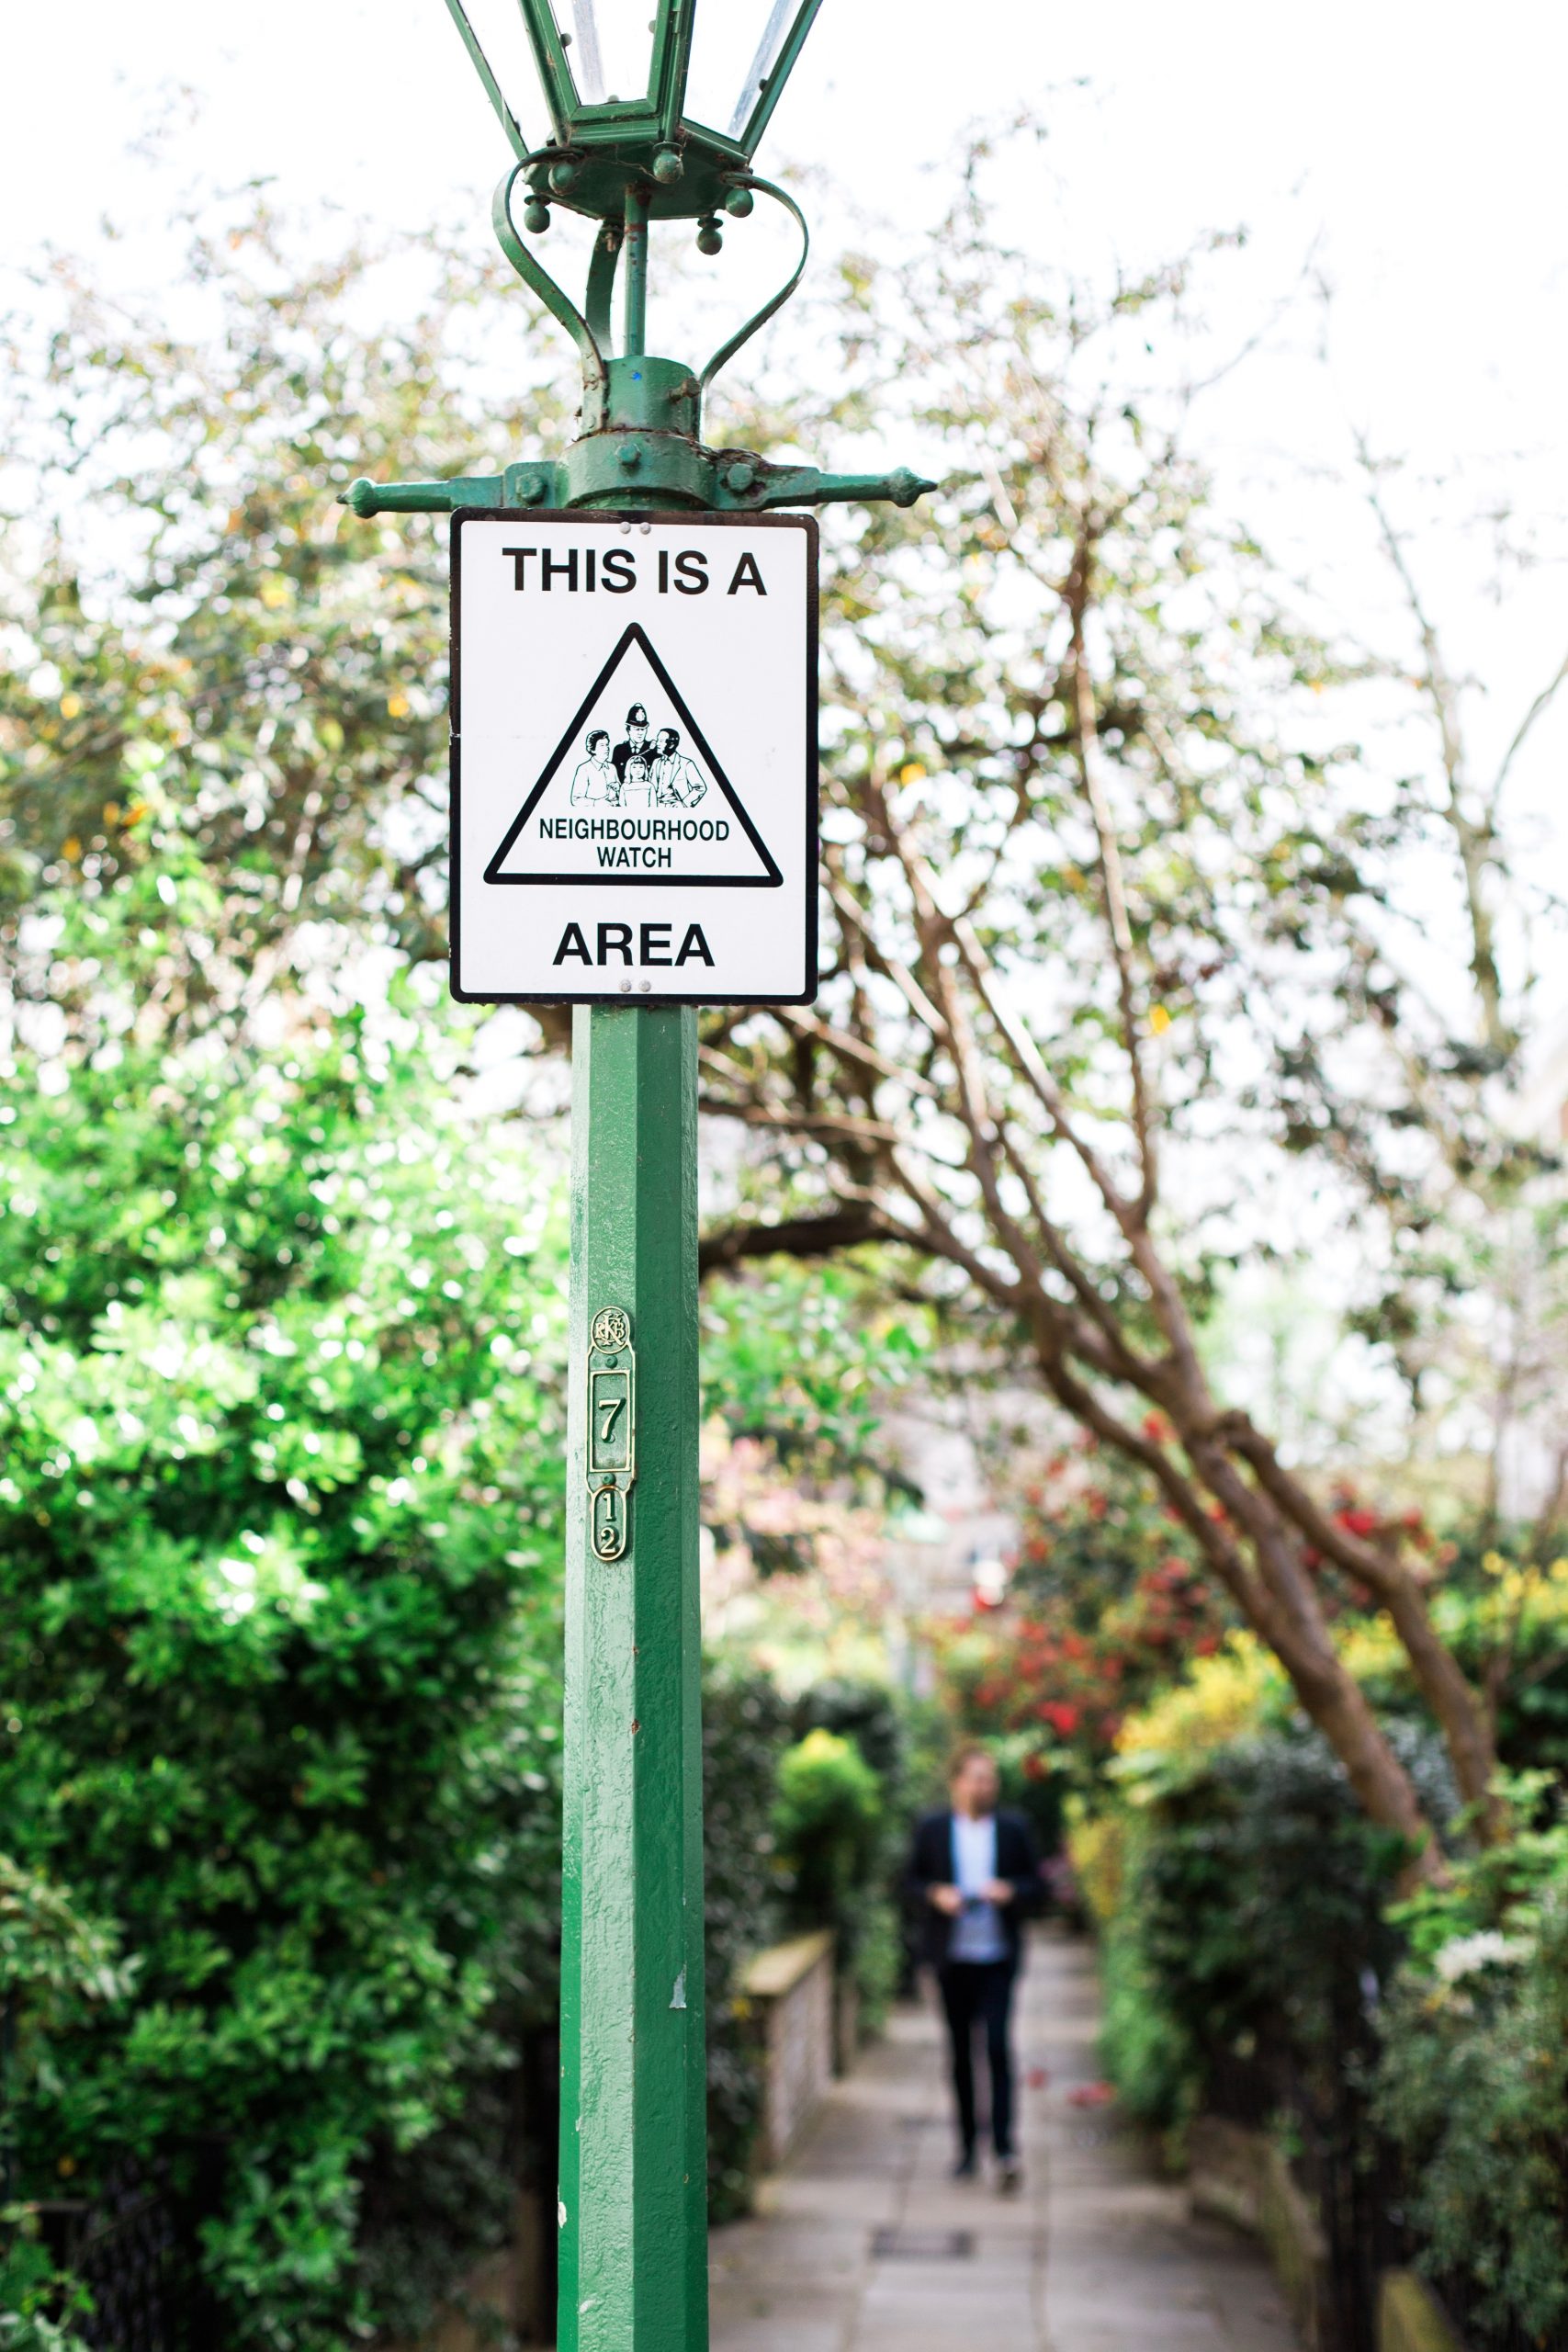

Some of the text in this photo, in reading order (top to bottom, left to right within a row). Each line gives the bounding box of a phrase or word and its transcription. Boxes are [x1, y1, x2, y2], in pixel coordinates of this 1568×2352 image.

[502, 548, 768, 596] THIS IS A
[540, 818, 729, 842] NEIGHBOURHOOD
[596, 846, 671, 868] WATCH
[552, 922, 716, 967] AREA
[598, 1398, 626, 1441] 7
